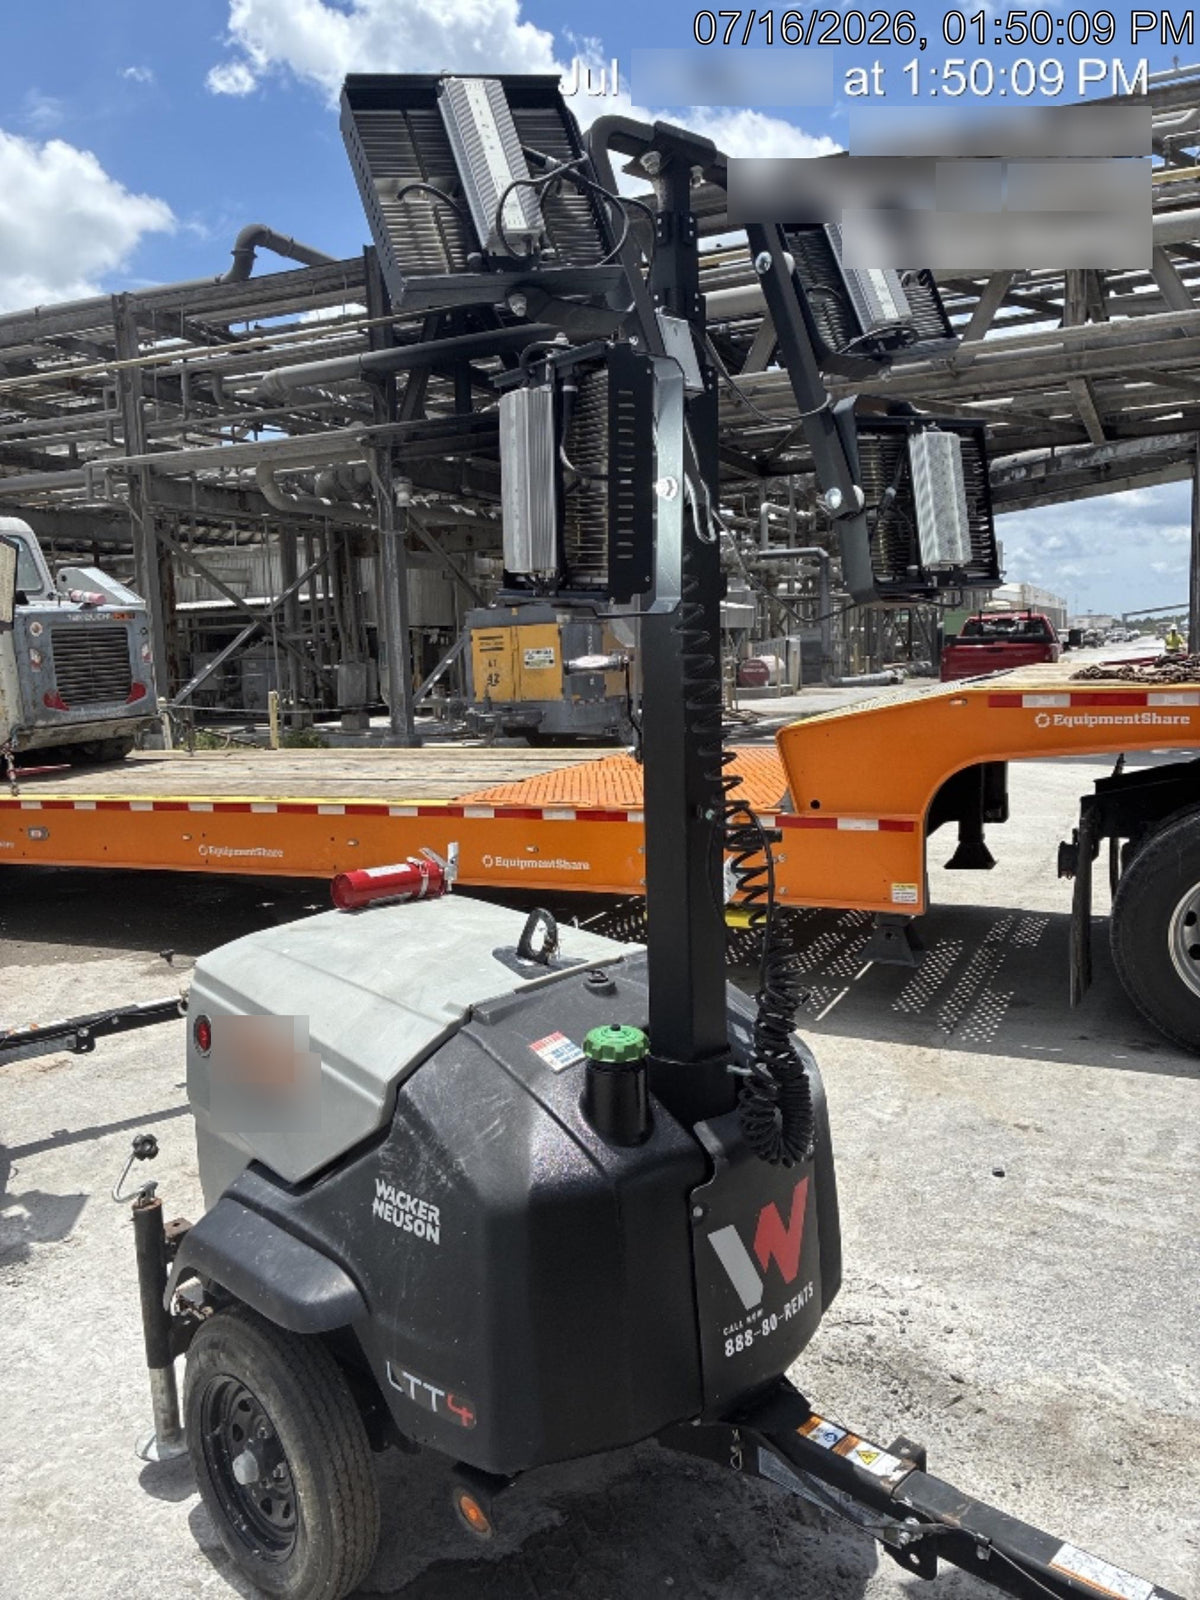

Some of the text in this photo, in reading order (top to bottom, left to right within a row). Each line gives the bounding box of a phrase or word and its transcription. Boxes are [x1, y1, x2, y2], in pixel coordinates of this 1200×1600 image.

[1053, 712, 1191, 728] EquipmentShare
[495, 855, 590, 871] EquipmentShare
[372, 1196, 440, 1246] NEUSON
[374, 1178, 441, 1227] WACKER
[722, 1320, 744, 1336] CALL
[724, 1281, 814, 1358] 888-80-RENTS
[386, 1360, 474, 1427] LTT4
